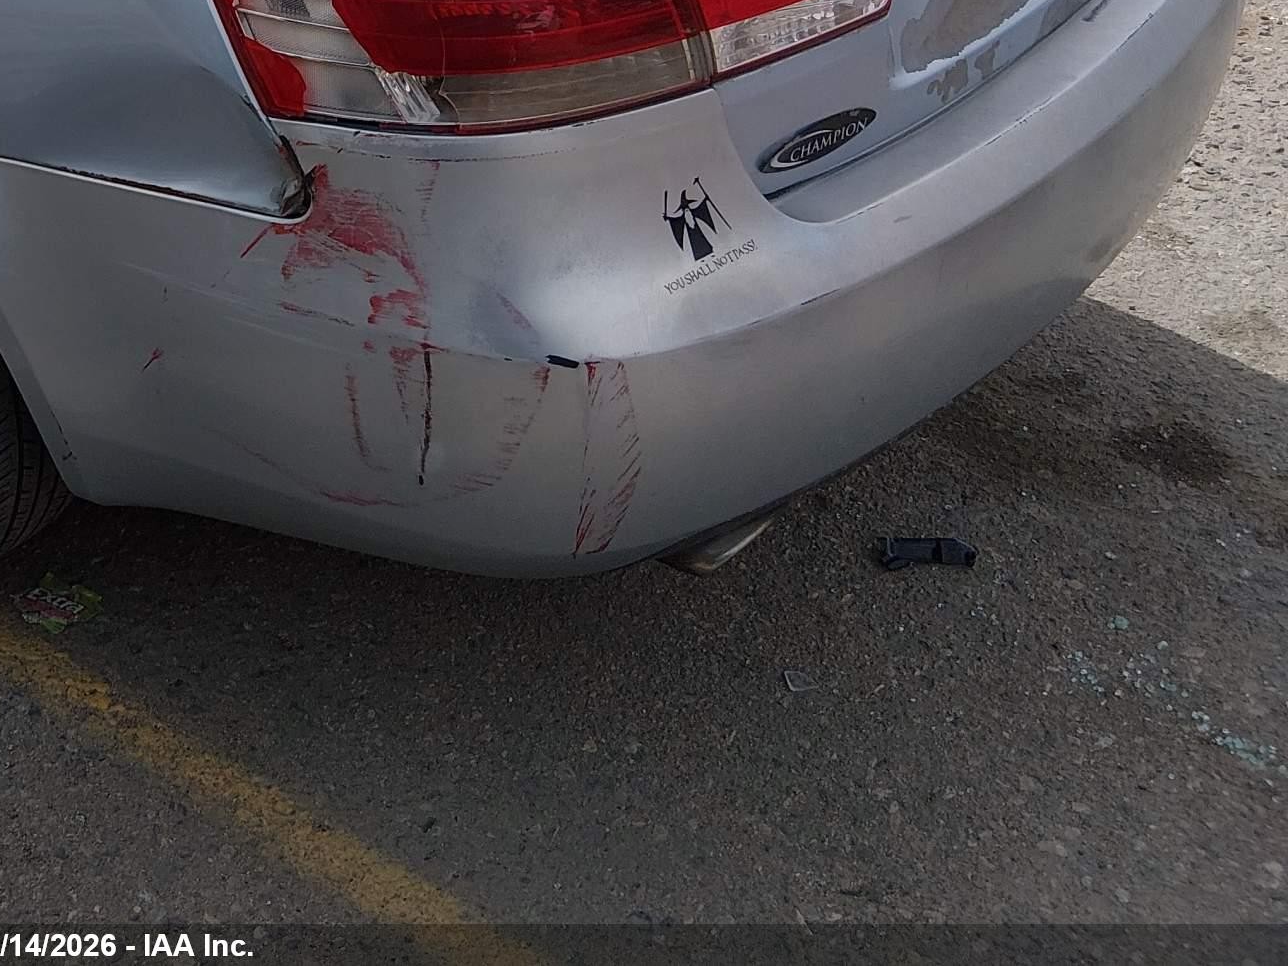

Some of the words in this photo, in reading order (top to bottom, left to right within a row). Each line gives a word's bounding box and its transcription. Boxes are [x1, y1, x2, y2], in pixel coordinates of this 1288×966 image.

[789, 117, 869, 162] CHAMPION
[663, 276, 686, 295] YOU
[683, 262, 717, 285] SHALL
[713, 250, 734, 270] NOT
